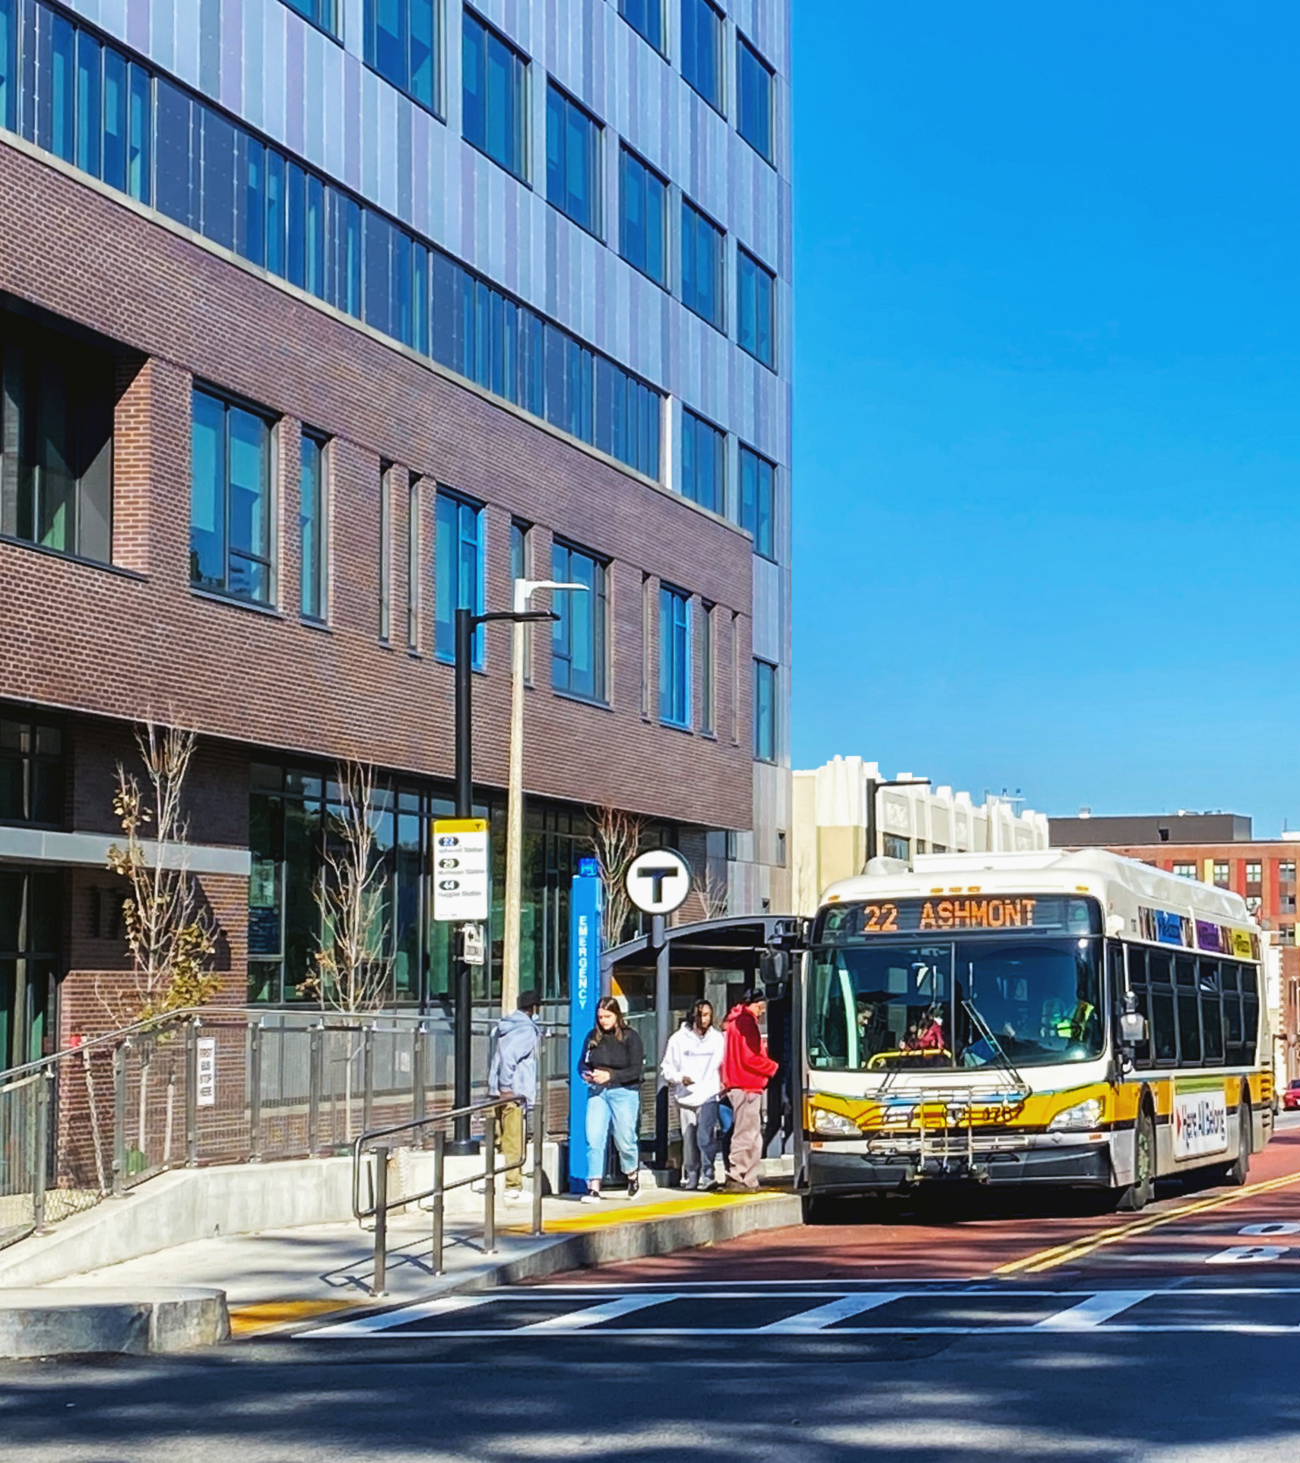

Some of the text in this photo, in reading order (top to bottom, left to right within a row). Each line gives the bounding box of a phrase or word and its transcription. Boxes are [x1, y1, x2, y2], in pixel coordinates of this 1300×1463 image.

[443, 837, 455, 847] 22
[443, 880, 455, 890] 44
[637, 866, 679, 904] T
[863, 899, 1037, 931] 22 ASHMONT
[578, 915, 589, 1010] EMERGENCY
